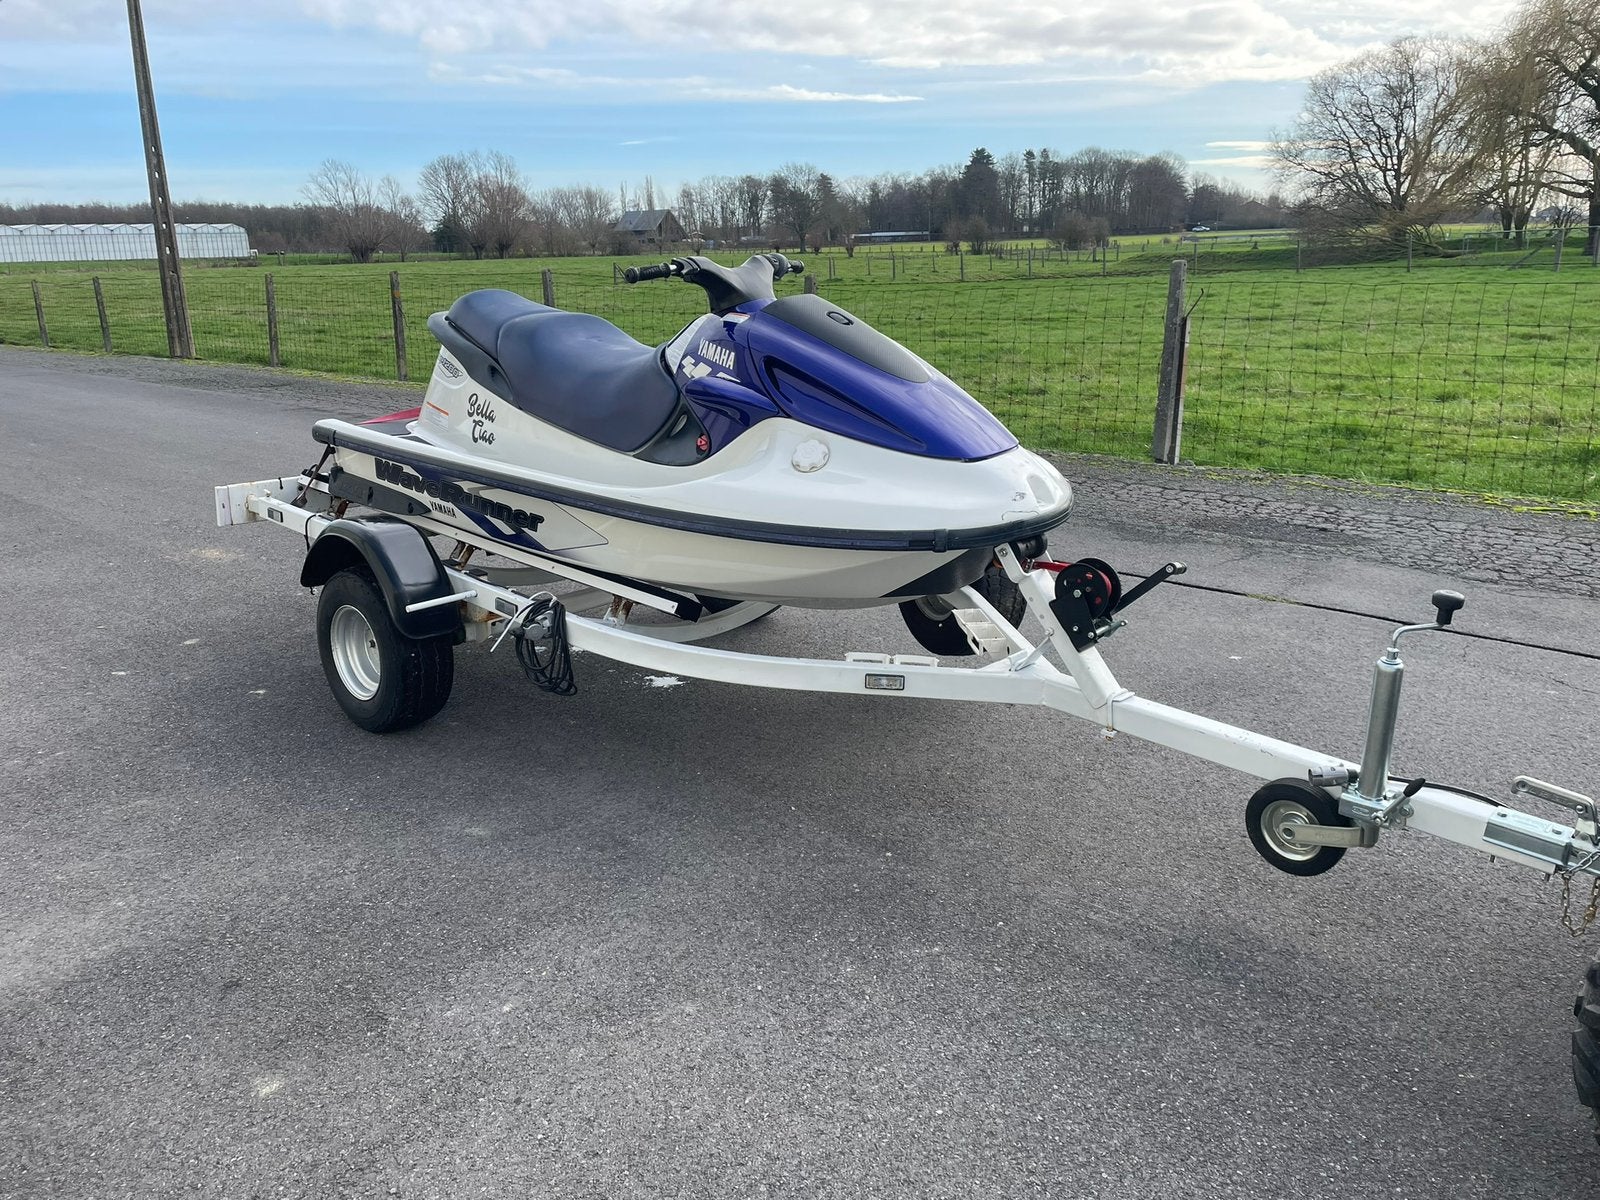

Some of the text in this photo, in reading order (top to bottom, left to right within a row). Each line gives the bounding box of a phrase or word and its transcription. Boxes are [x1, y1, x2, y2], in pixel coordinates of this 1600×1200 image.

[698, 337, 736, 370] YAMAHA
[467, 393, 496, 423] Bella
[472, 419, 496, 445] Ciao
[374, 457, 545, 532] WaveRunner
[429, 501, 457, 518] YAMAHA
